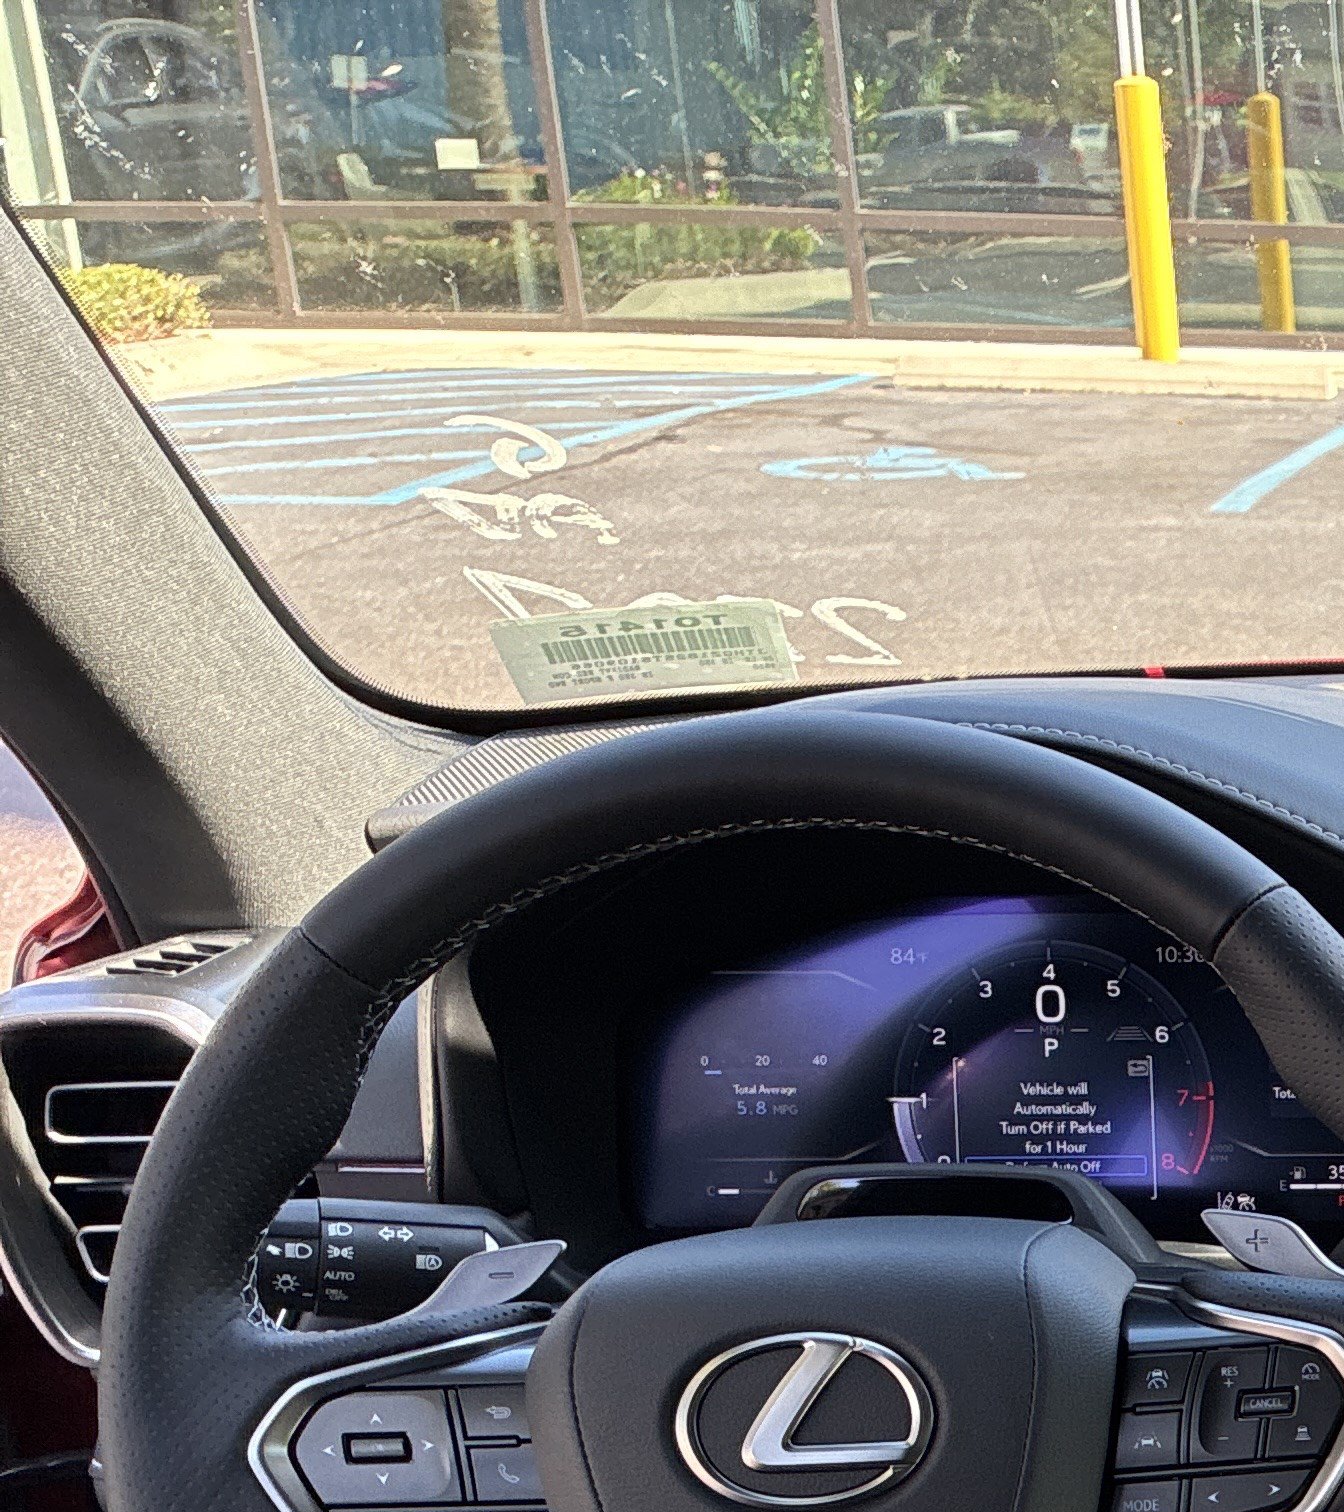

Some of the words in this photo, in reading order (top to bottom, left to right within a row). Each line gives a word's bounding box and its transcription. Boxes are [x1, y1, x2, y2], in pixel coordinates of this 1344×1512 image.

[1042, 964, 1056, 981] 4
[979, 981, 993, 998] 3
[1106, 980, 1121, 997] 5
[1035, 984, 1066, 1025] 0
[932, 1027, 947, 1046] 2
[1155, 1026, 1169, 1043] 6
[1044, 1038, 1059, 1058] P
[700, 1055, 709, 1067] 0
[754, 1055, 771, 1067] 20
[811, 1054, 828, 1067] 40
[733, 1084, 757, 1096] Total
[758, 1084, 797, 1097] Average
[1019, 1082, 1065, 1096] Vehicle
[1067, 1082, 1089, 1096] will
[1177, 1089, 1189, 1106] 7
[736, 1101, 768, 1116] 5.8
[772, 1104, 799, 1116] MPG
[1012, 1102, 1097, 1117] Automatically
[999, 1121, 1028, 1135] Turn
[1030, 1121, 1054, 1135] Off
[1056, 1121, 1065, 1135] if
[1068, 1121, 1112, 1135] Parked
[1025, 1140, 1044, 1154] for
[1046, 1140, 1053, 1153] 1
[1056, 1140, 1087, 1154] Hour
[1080, 1160, 1101, 1173] Off
[1161, 1153, 1175, 1170] 8
[323, 1270, 355, 1281] AUTO
[1220, 1366, 1239, 1377] RES
[1250, 1399, 1283, 1409] CANCEL
[1122, 1498, 1160, 1512] MODE
